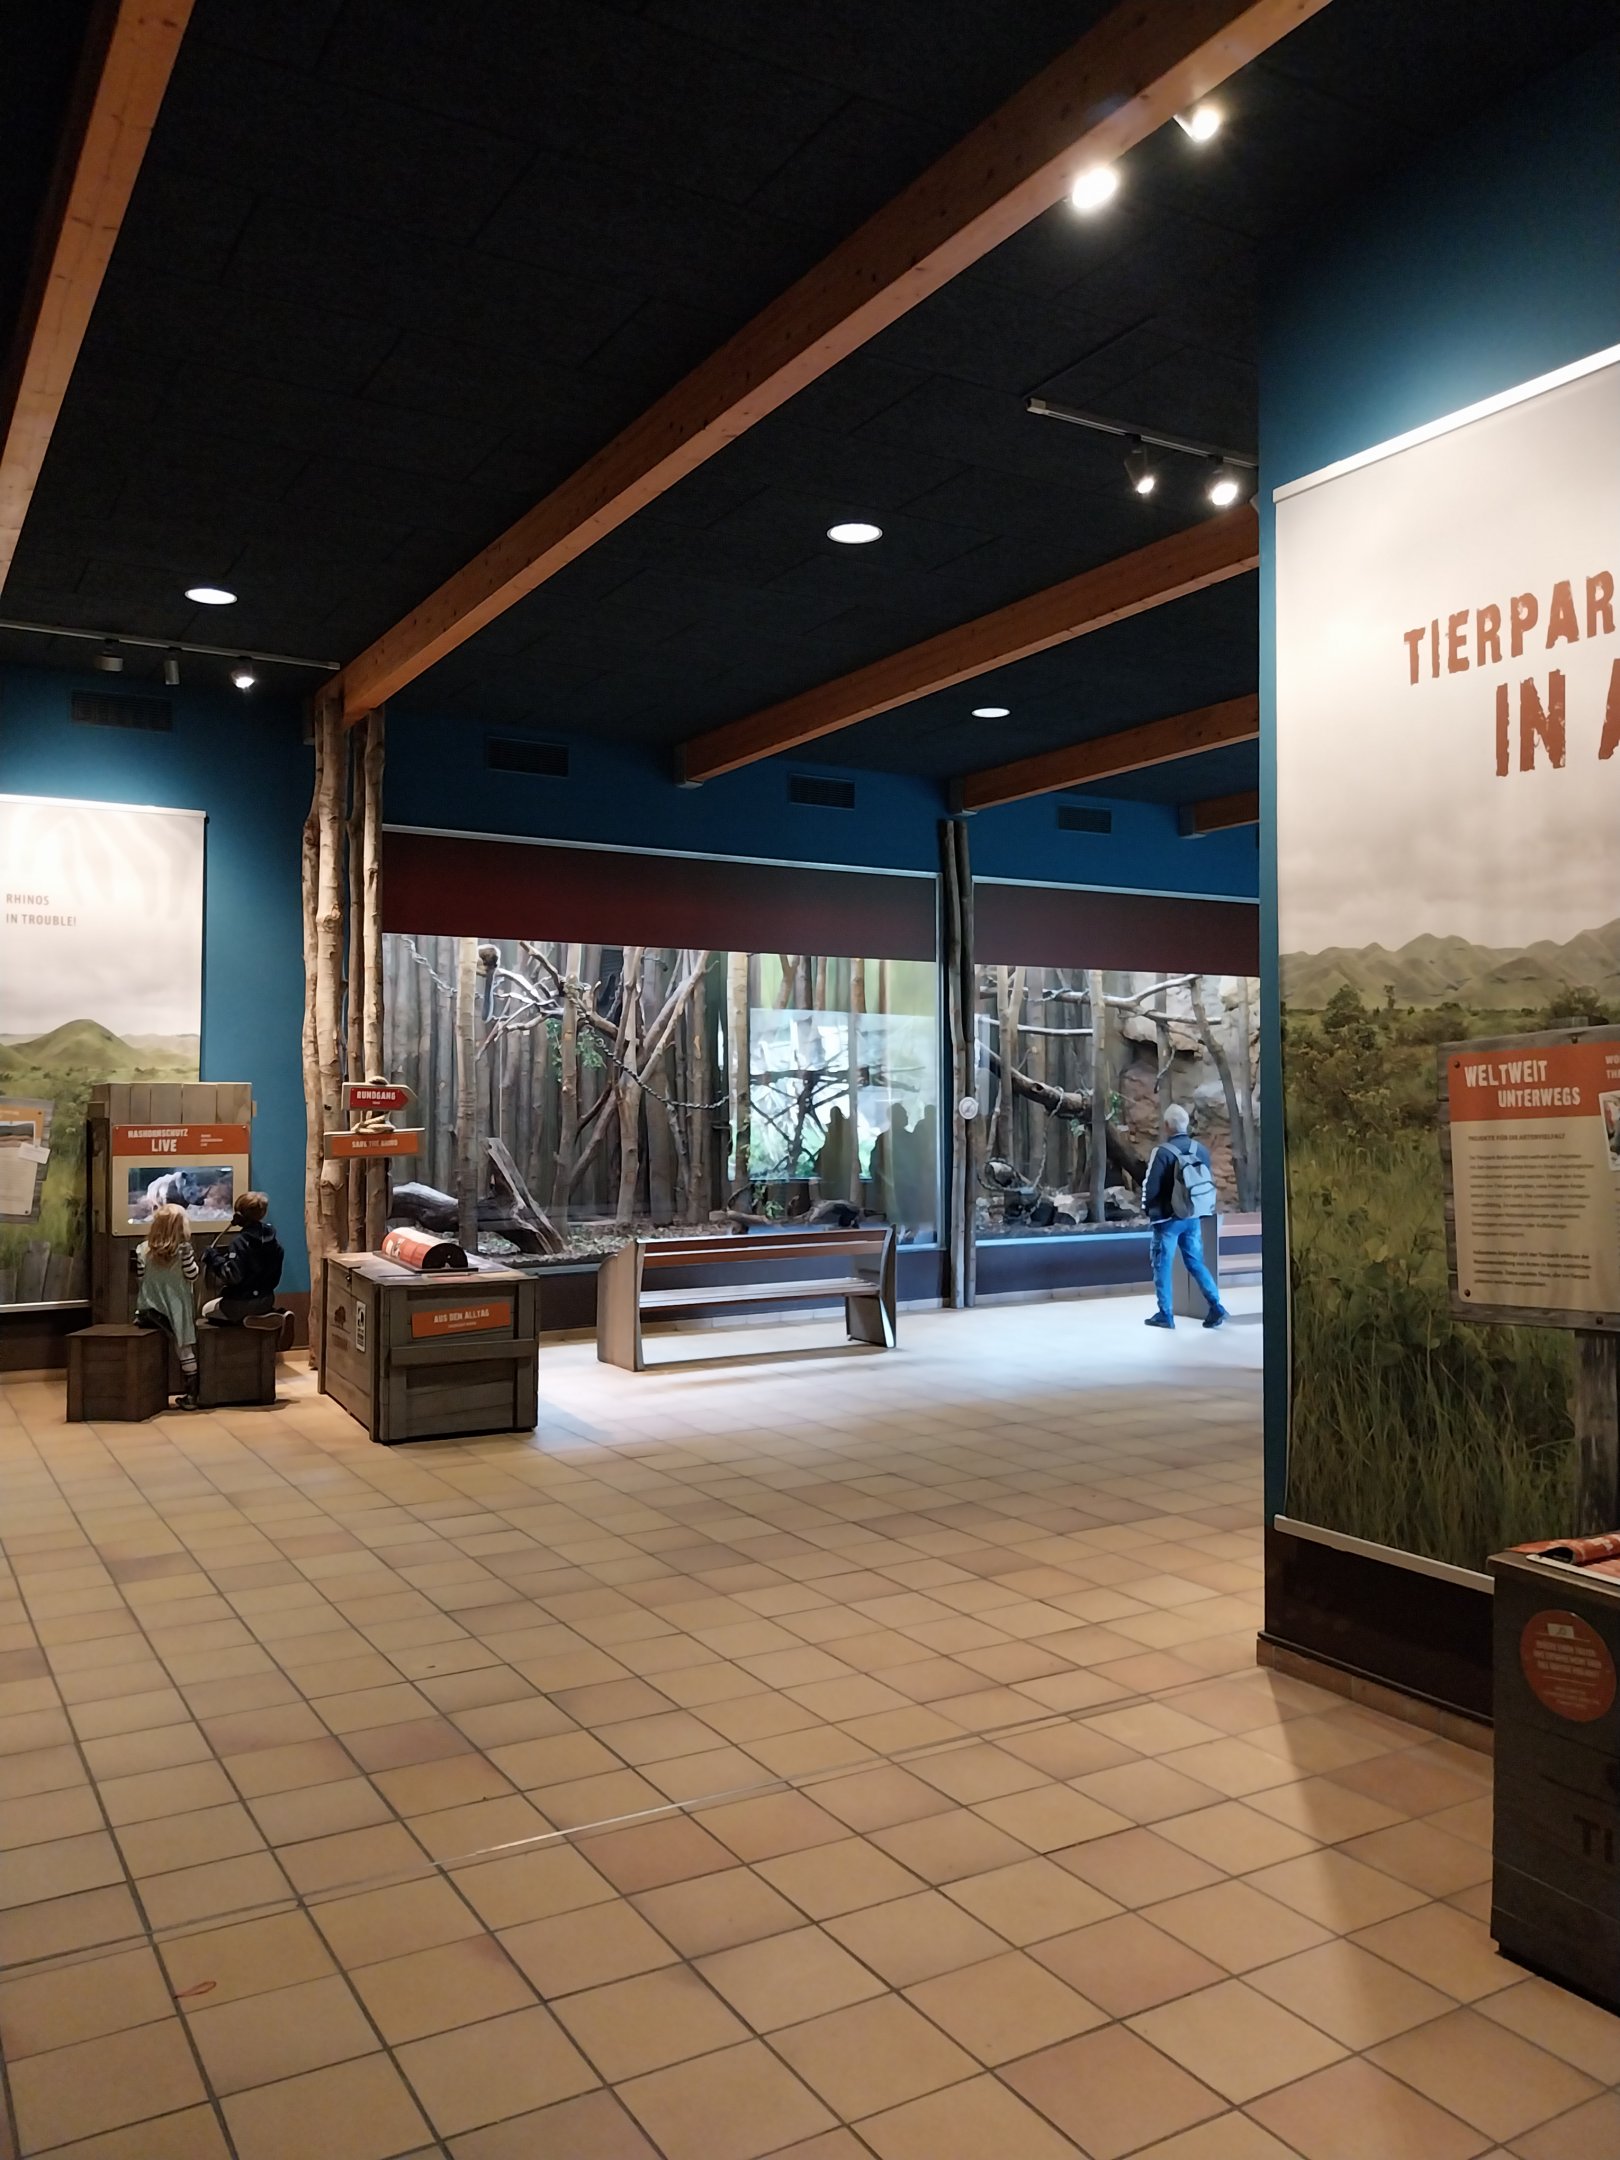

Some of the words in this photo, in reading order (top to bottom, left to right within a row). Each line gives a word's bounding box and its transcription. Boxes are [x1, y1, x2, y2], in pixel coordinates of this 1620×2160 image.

[1403, 570, 1616, 686] TIERPAR
[1495, 668, 1566, 777] IN
[6, 893, 50, 906] RHINOS
[6, 913, 18, 924] IN
[21, 913, 77, 927] TROUBLE!
[1464, 1060, 1548, 1087] WELTWEIT
[356, 1090, 396, 1101] RUNDGANG
[1497, 1087, 1581, 1108] UNTERWEGS
[151, 1138, 178, 1153] LIVE
[433, 1314, 448, 1323] AUS
[464, 1308, 490, 1320] ALLTAG
